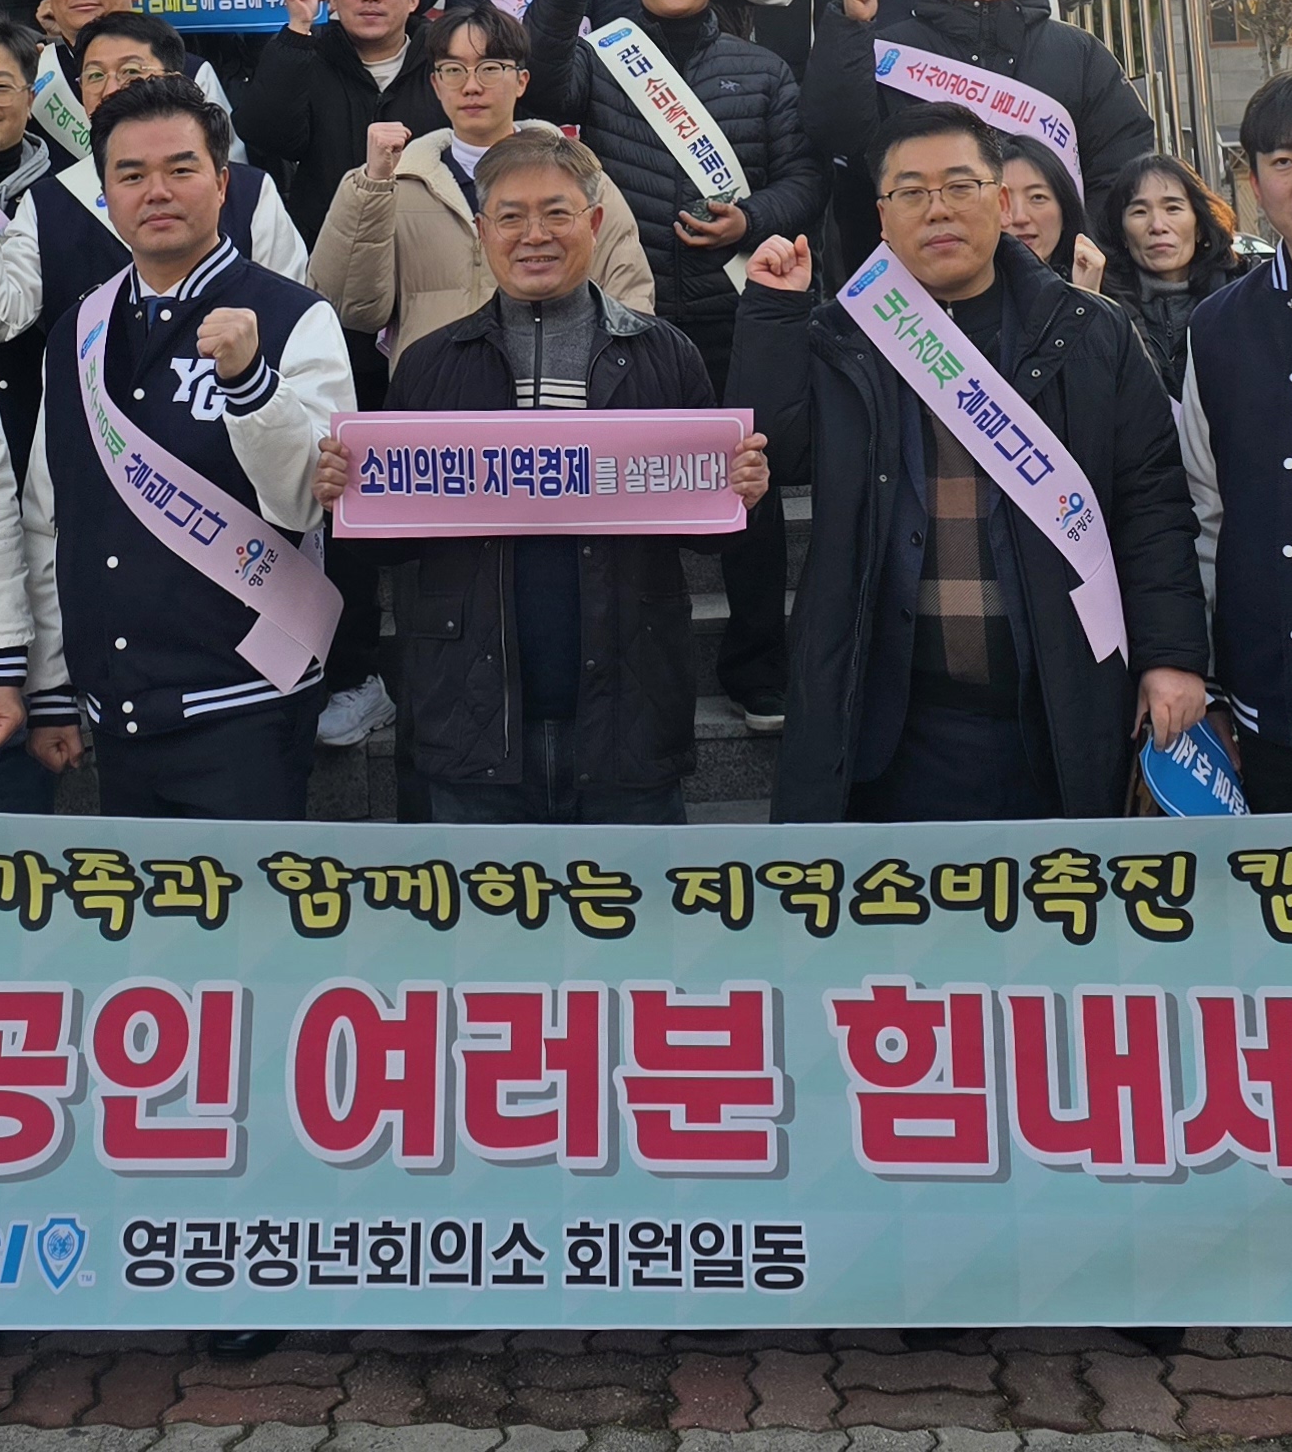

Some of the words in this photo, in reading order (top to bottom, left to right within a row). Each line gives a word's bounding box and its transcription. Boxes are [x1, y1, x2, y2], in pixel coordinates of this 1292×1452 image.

[617, 44, 653, 78] 관내
[644, 77, 701, 141] 소비촉진
[687, 134, 734, 191] 캠페인
[906, 63, 991, 103] 소상공인
[990, 91, 1036, 124] 돕는
[1039, 114, 1070, 149] 소비
[872, 288, 965, 390] 내수경제
[956, 378, 1055, 486] 살립니다
[84, 356, 126, 463] 내수경제
[124, 452, 228, 547] 살립니다
[360, 446, 475, 496] 소비의힘!
[482, 445, 590, 497] 지역경제
[624, 452, 727, 494] 살립시다!
[248, 548, 279, 587] 영광군
[1066, 508, 1095, 541] 영광군
[257, 850, 639, 939] 함께하는
[672, 847, 1196, 944] 지역소비촉진
[295, 987, 776, 1160] 여러분
[121, 1219, 545, 1290] 영광청년회의소
[564, 1218, 807, 1289] 회원일동
